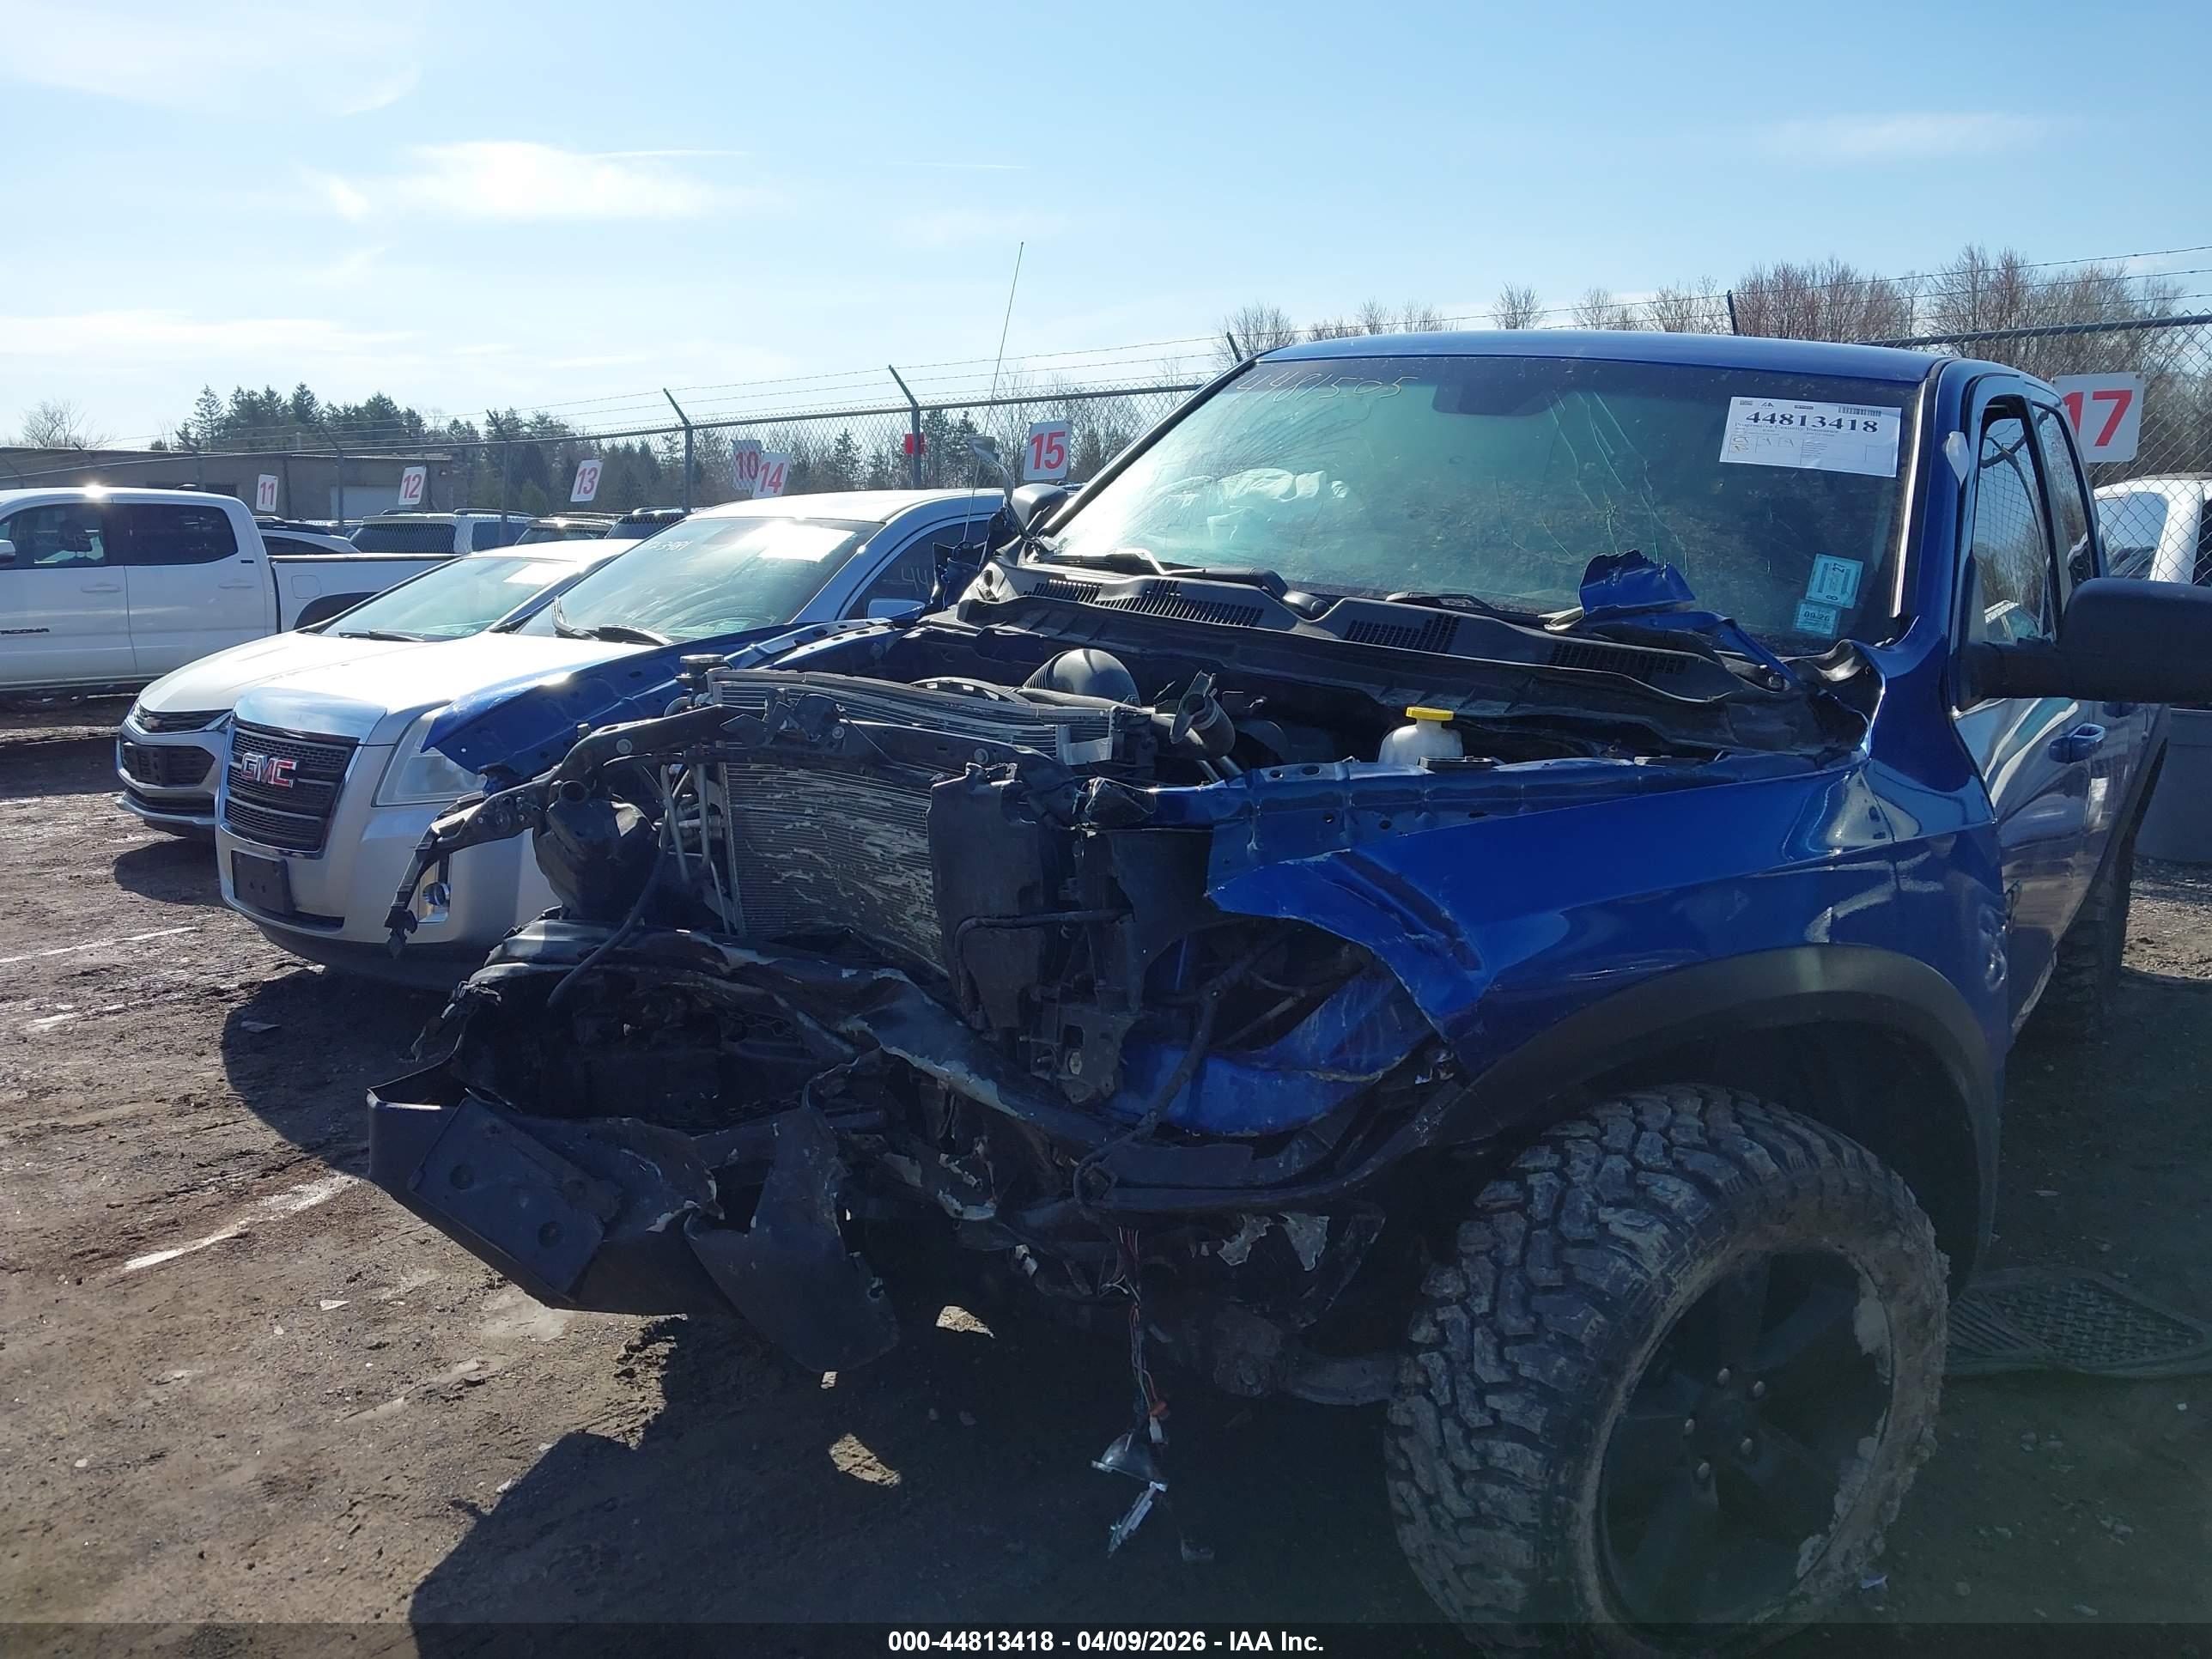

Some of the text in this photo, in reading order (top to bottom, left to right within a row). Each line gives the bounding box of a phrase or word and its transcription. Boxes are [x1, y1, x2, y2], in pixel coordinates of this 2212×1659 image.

[1746, 411, 1879, 433] 44813418
[2063, 390, 2133, 447] 17
[1030, 431, 1066, 470] 15
[736, 452, 759, 480] 10
[760, 461, 785, 494] 14
[260, 482, 275, 506] 11
[403, 473, 422, 499] 12
[577, 467, 599, 495] 13
[241, 752, 298, 788] GMC
